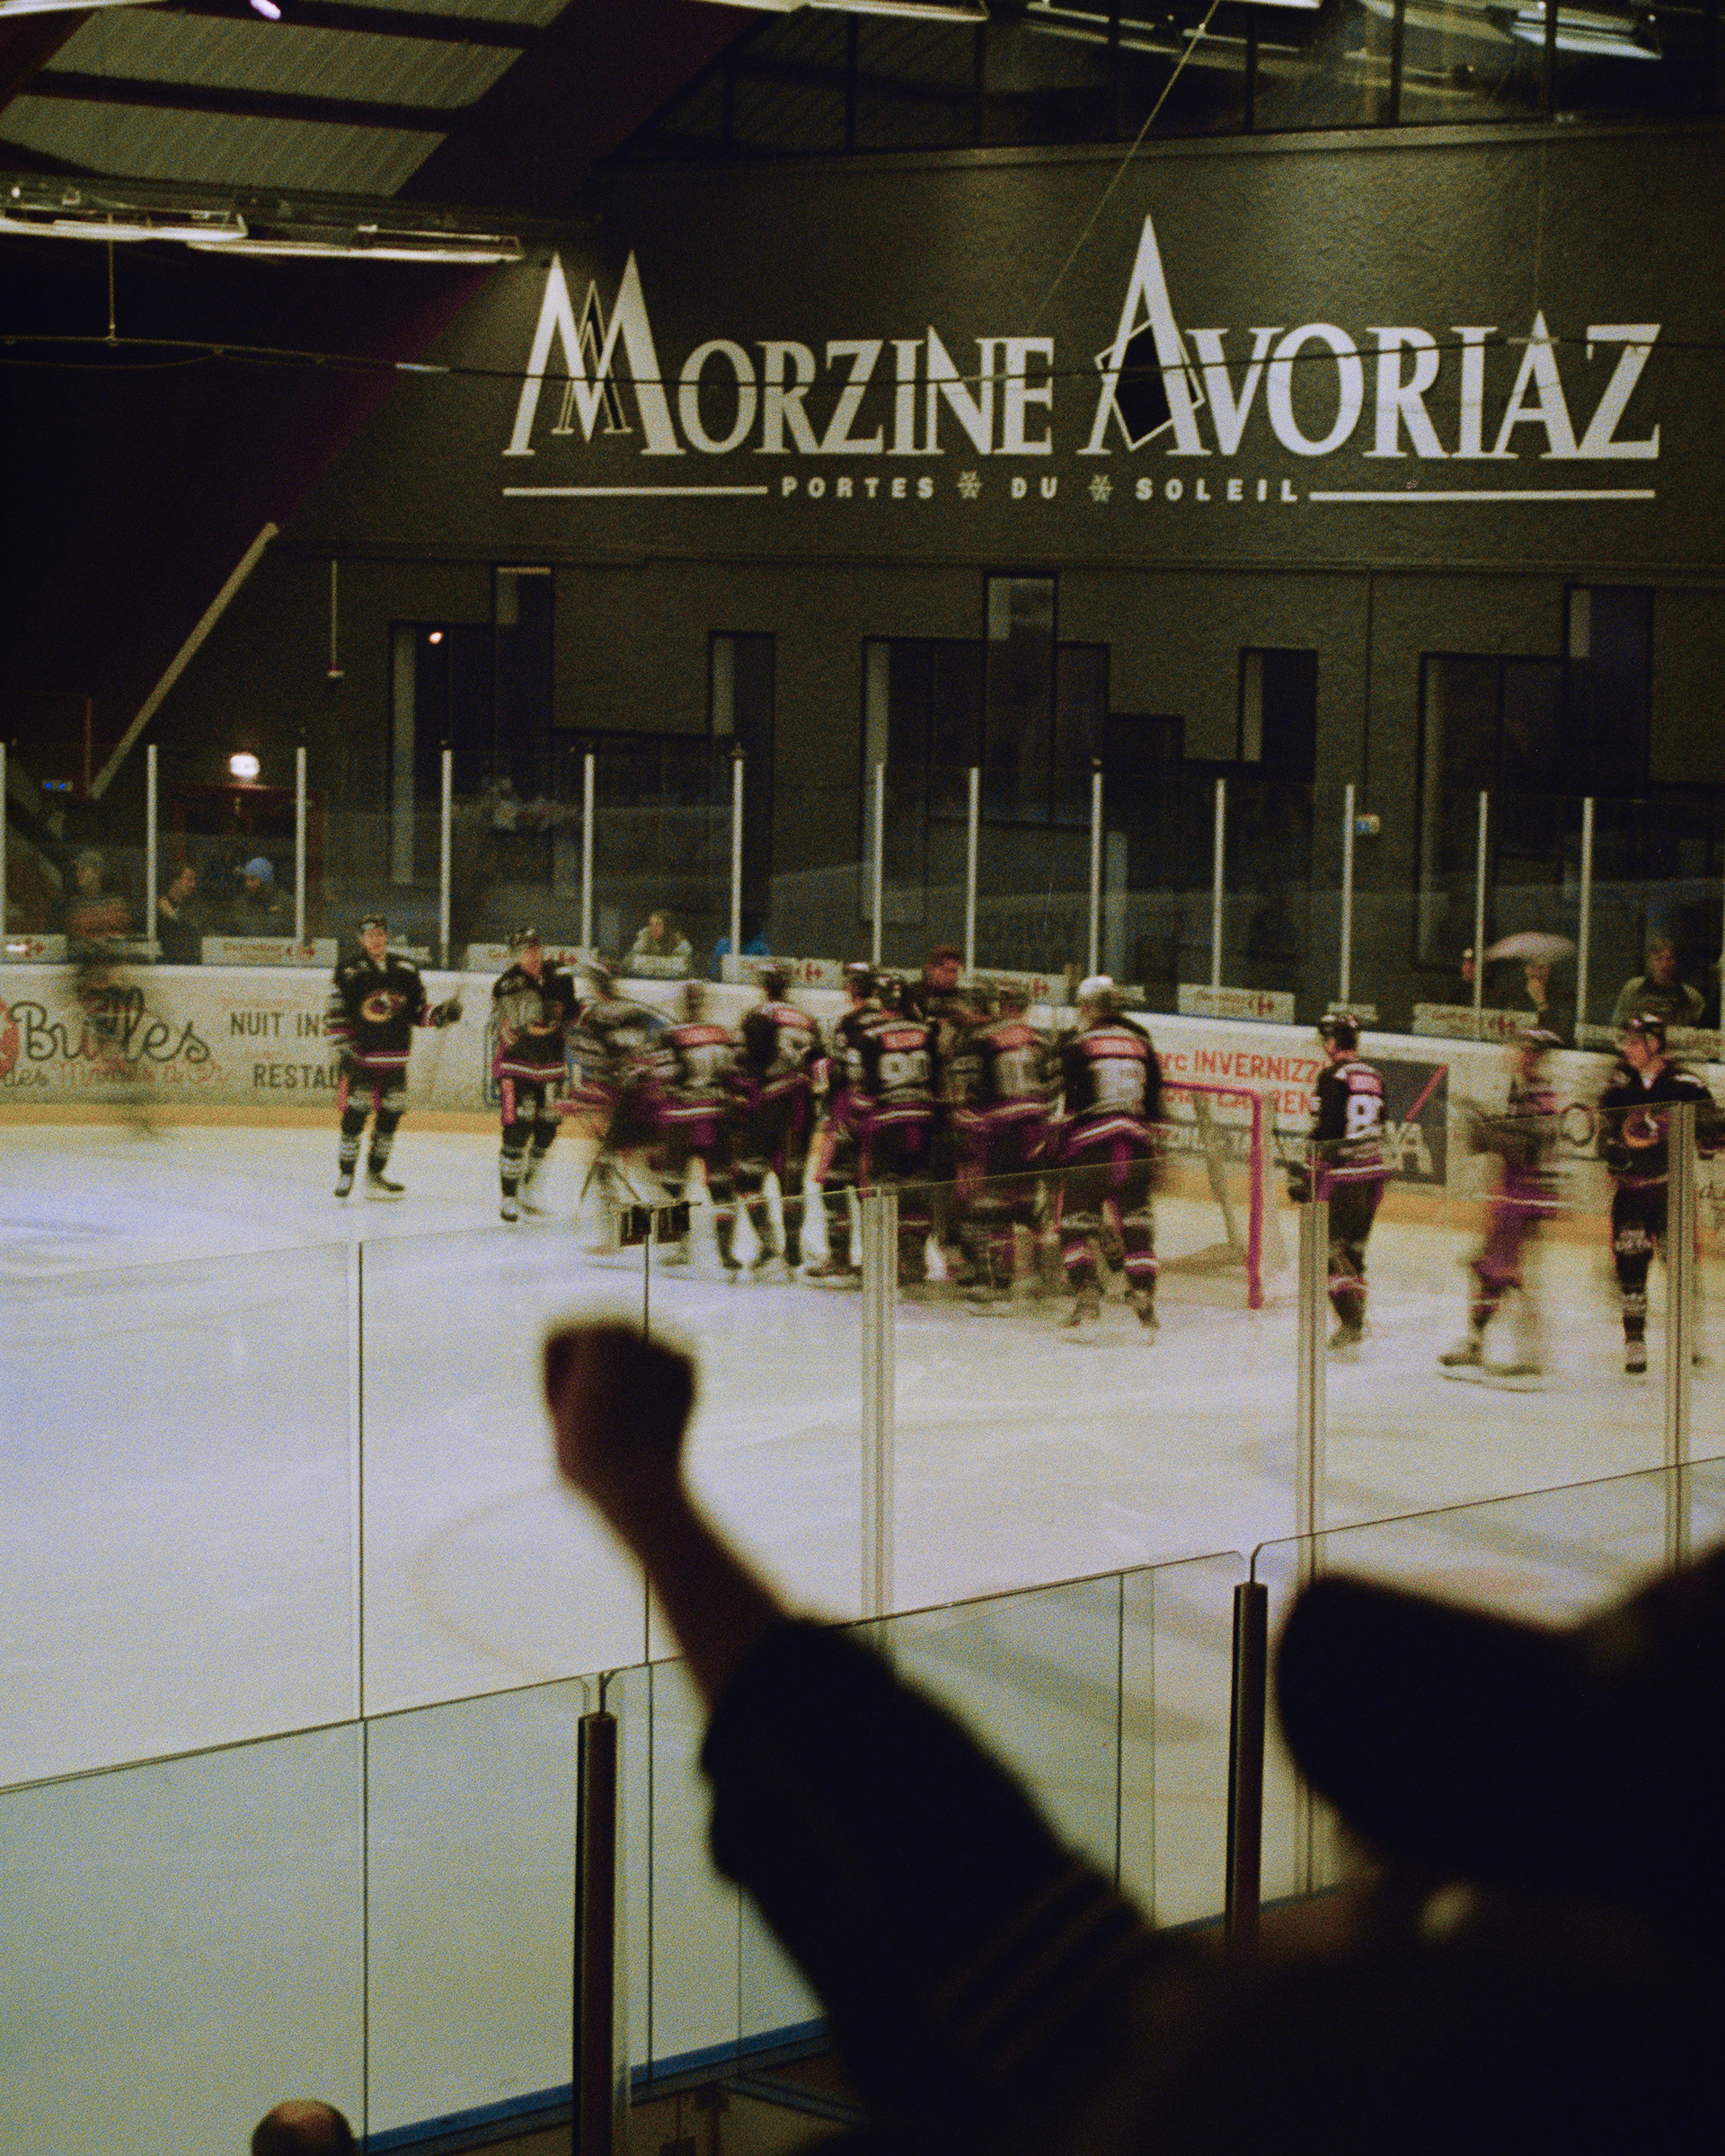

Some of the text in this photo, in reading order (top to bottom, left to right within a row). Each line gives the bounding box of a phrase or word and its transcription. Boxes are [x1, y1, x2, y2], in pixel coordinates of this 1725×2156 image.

[1076, 214, 1661, 461] AVORIAZ
[781, 476, 1299, 503] PORTES DU SOLEIL
[230, 1011, 284, 1037] NUIT
